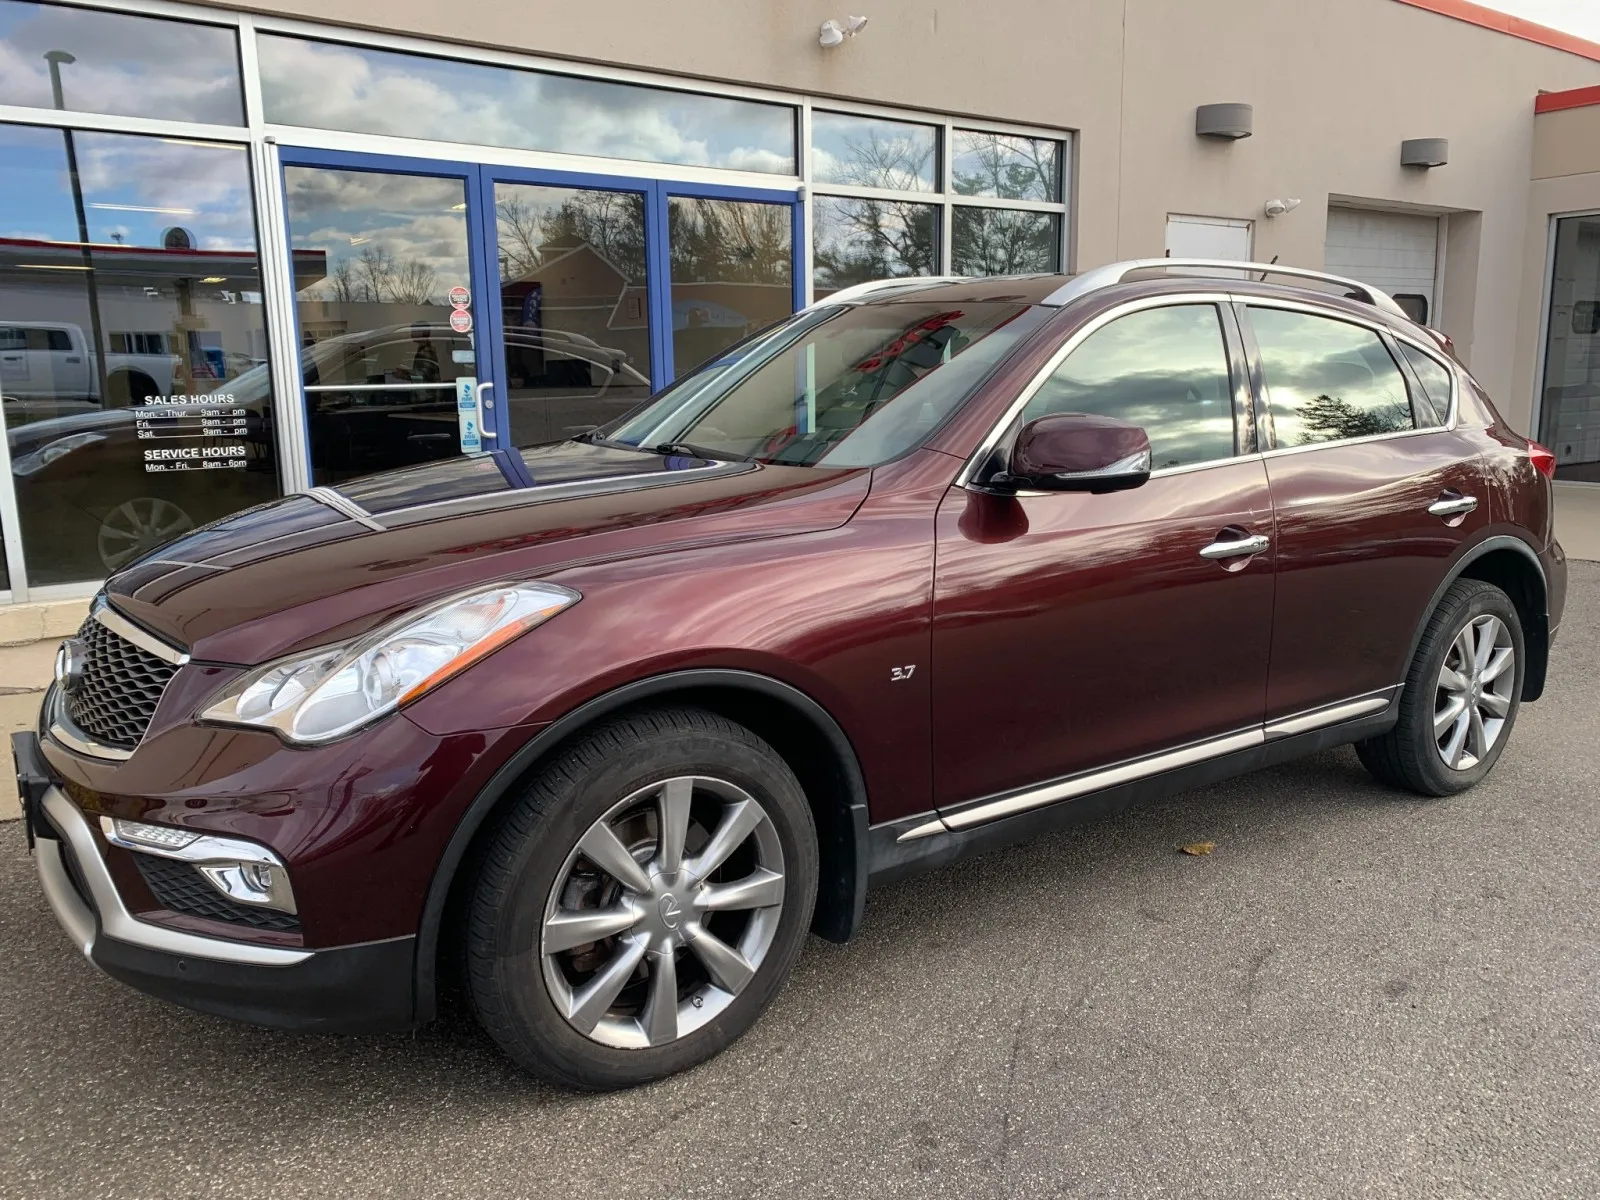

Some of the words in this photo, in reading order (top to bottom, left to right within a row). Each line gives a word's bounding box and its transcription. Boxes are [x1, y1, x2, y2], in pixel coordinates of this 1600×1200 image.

[144, 395, 187, 405] SALES
[190, 394, 235, 404] HOURS
[135, 410, 157, 418] Mon.
[165, 409, 188, 417] Thur.
[200, 408, 220, 416] 9am
[232, 408, 246, 416] pm
[136, 420, 151, 428] Fri.
[201, 418, 220, 426] 9am
[233, 418, 246, 426] pm
[137, 430, 155, 438] Sat.
[144, 448, 199, 460] SERVICE
[202, 446, 246, 457] HOURS
[145, 463, 168, 471] Mon.
[202, 460, 221, 468] 8am
[228, 460, 247, 468] 6pm
[891, 664, 916, 681] 3.7
